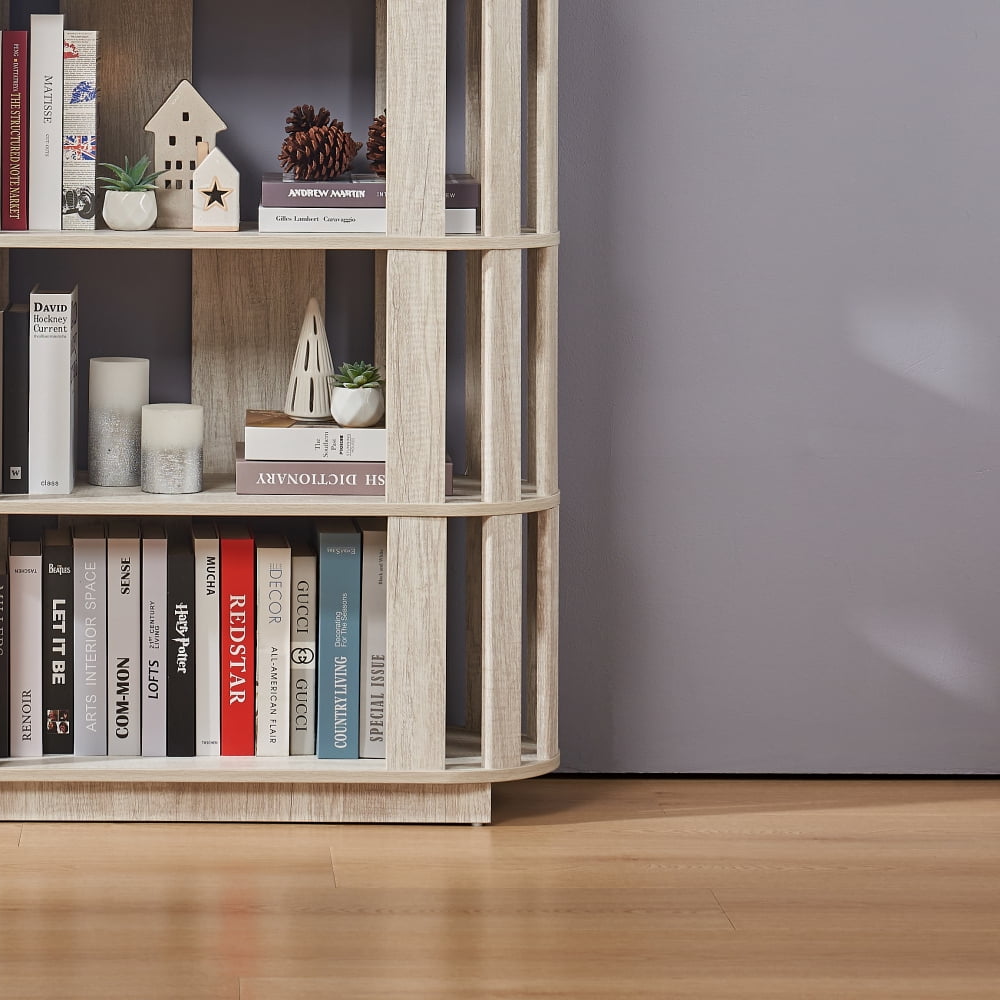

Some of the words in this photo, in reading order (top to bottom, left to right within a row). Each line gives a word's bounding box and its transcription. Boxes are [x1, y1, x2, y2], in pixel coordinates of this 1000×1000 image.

[10, 92, 21, 109] THE
[43, 75, 53, 124] MATISSE
[9, 110, 21, 163] STRUCTURED
[9, 163, 20, 186] NOTE
[287, 188, 329, 198] ANDREW
[329, 189, 366, 198] MARTIN
[323, 215, 356, 223] Caravaggio
[33, 302, 68, 312] DAVID
[33, 314, 68, 324] Hockney
[33, 324, 68, 333] Current
[40, 479, 59, 487] class
[256, 472, 357, 486] DICTIONARY
[84, 561, 97, 610] SPACE
[120, 556, 131, 595] SENSE
[206, 556, 216, 596] MUCHA
[268, 568, 282, 624] DECOR
[296, 580, 310, 633] GUCCI
[52, 599, 66, 633] LET
[174, 602, 189, 637] Harry
[334, 611, 342, 648] Decorating
[52, 638, 66, 656] IT
[84, 616, 97, 686] INTERIOR
[171, 637, 190, 674] Potter
[229, 594, 247, 706] REDSTAR
[51, 660, 66, 685] BE
[148, 659, 159, 700] LOFTS
[270, 646, 278, 715] ALL-AMERICAN
[334, 656, 348, 695] LIVING
[371, 654, 385, 688] ISSUE
[22, 689, 32, 742] RENOIR
[85, 694, 97, 733] ARTS
[115, 657, 130, 739] COM-MON
[295, 678, 308, 732] GUCCI
[369, 692, 385, 742] SPECIAL
[269, 719, 277, 744] FLAIR
[334, 697, 348, 749] COUNTRY
